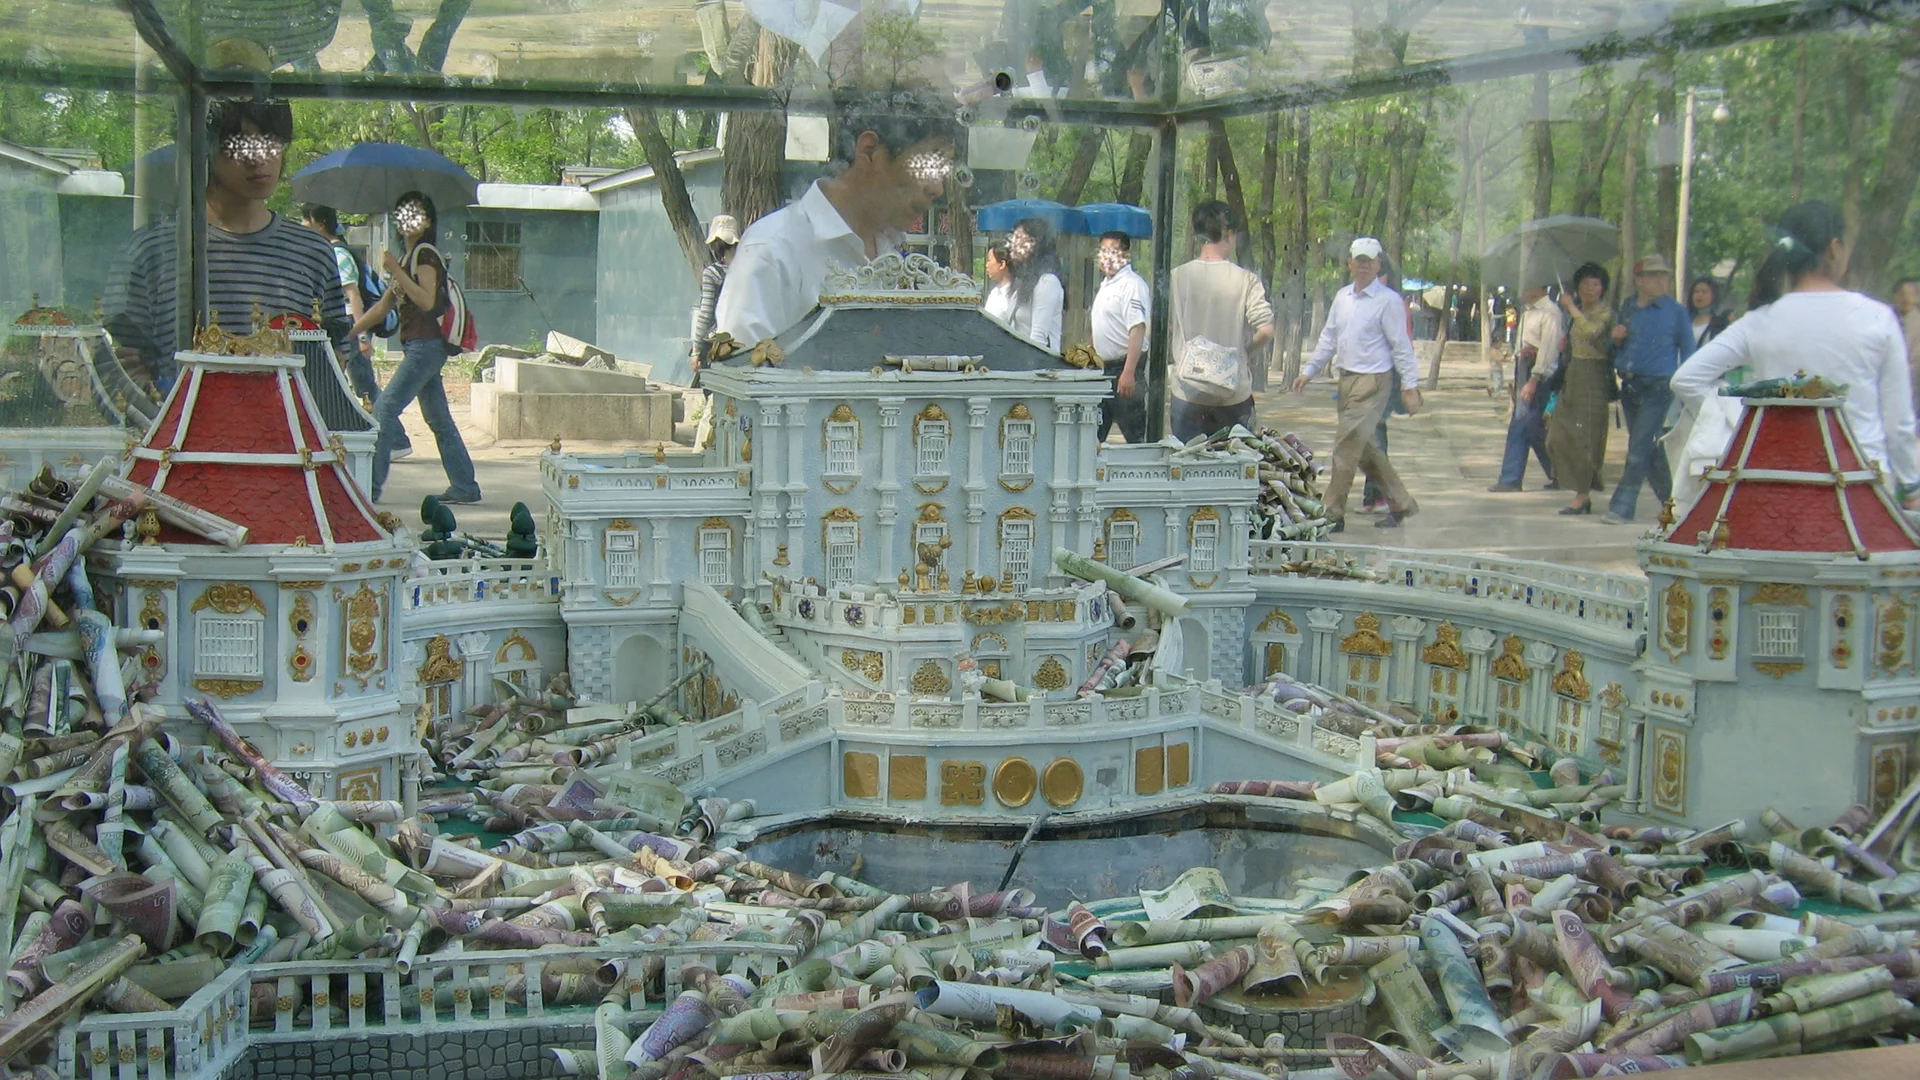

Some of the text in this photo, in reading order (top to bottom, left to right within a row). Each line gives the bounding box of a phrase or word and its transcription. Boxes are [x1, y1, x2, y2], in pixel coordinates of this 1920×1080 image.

[226, 861, 252, 876] YUAN
[154, 895, 167, 908] 5
[947, 902, 960, 912] 5
[72, 915, 84, 930] 5
[1567, 923, 1580, 933] 5
